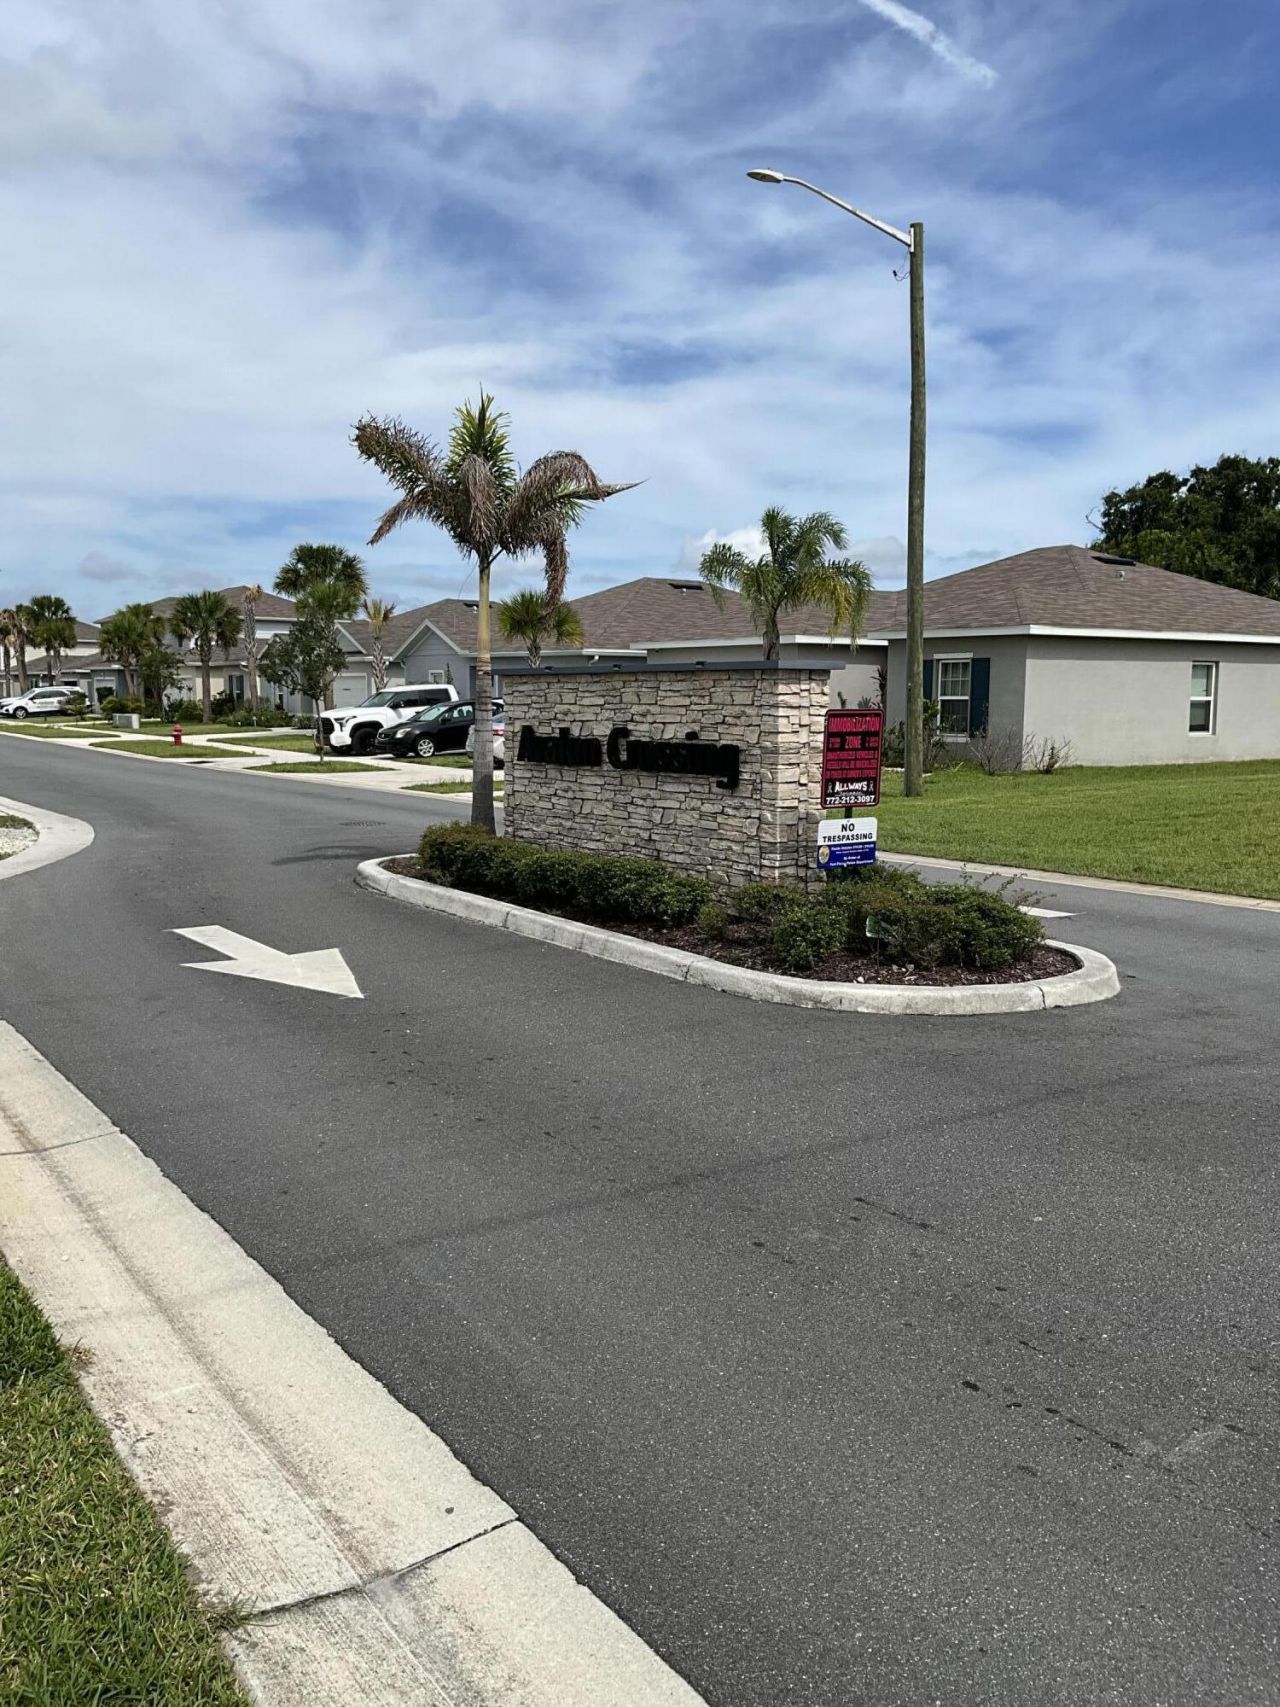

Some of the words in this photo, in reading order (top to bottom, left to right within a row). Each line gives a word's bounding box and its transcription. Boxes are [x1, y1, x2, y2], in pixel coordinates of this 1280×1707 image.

[845, 735, 862, 749] ZONE
[825, 795, 875, 805] 772-212-3097
[841, 823, 855, 832] NO
[822, 832, 873, 843] TRESPASSING
